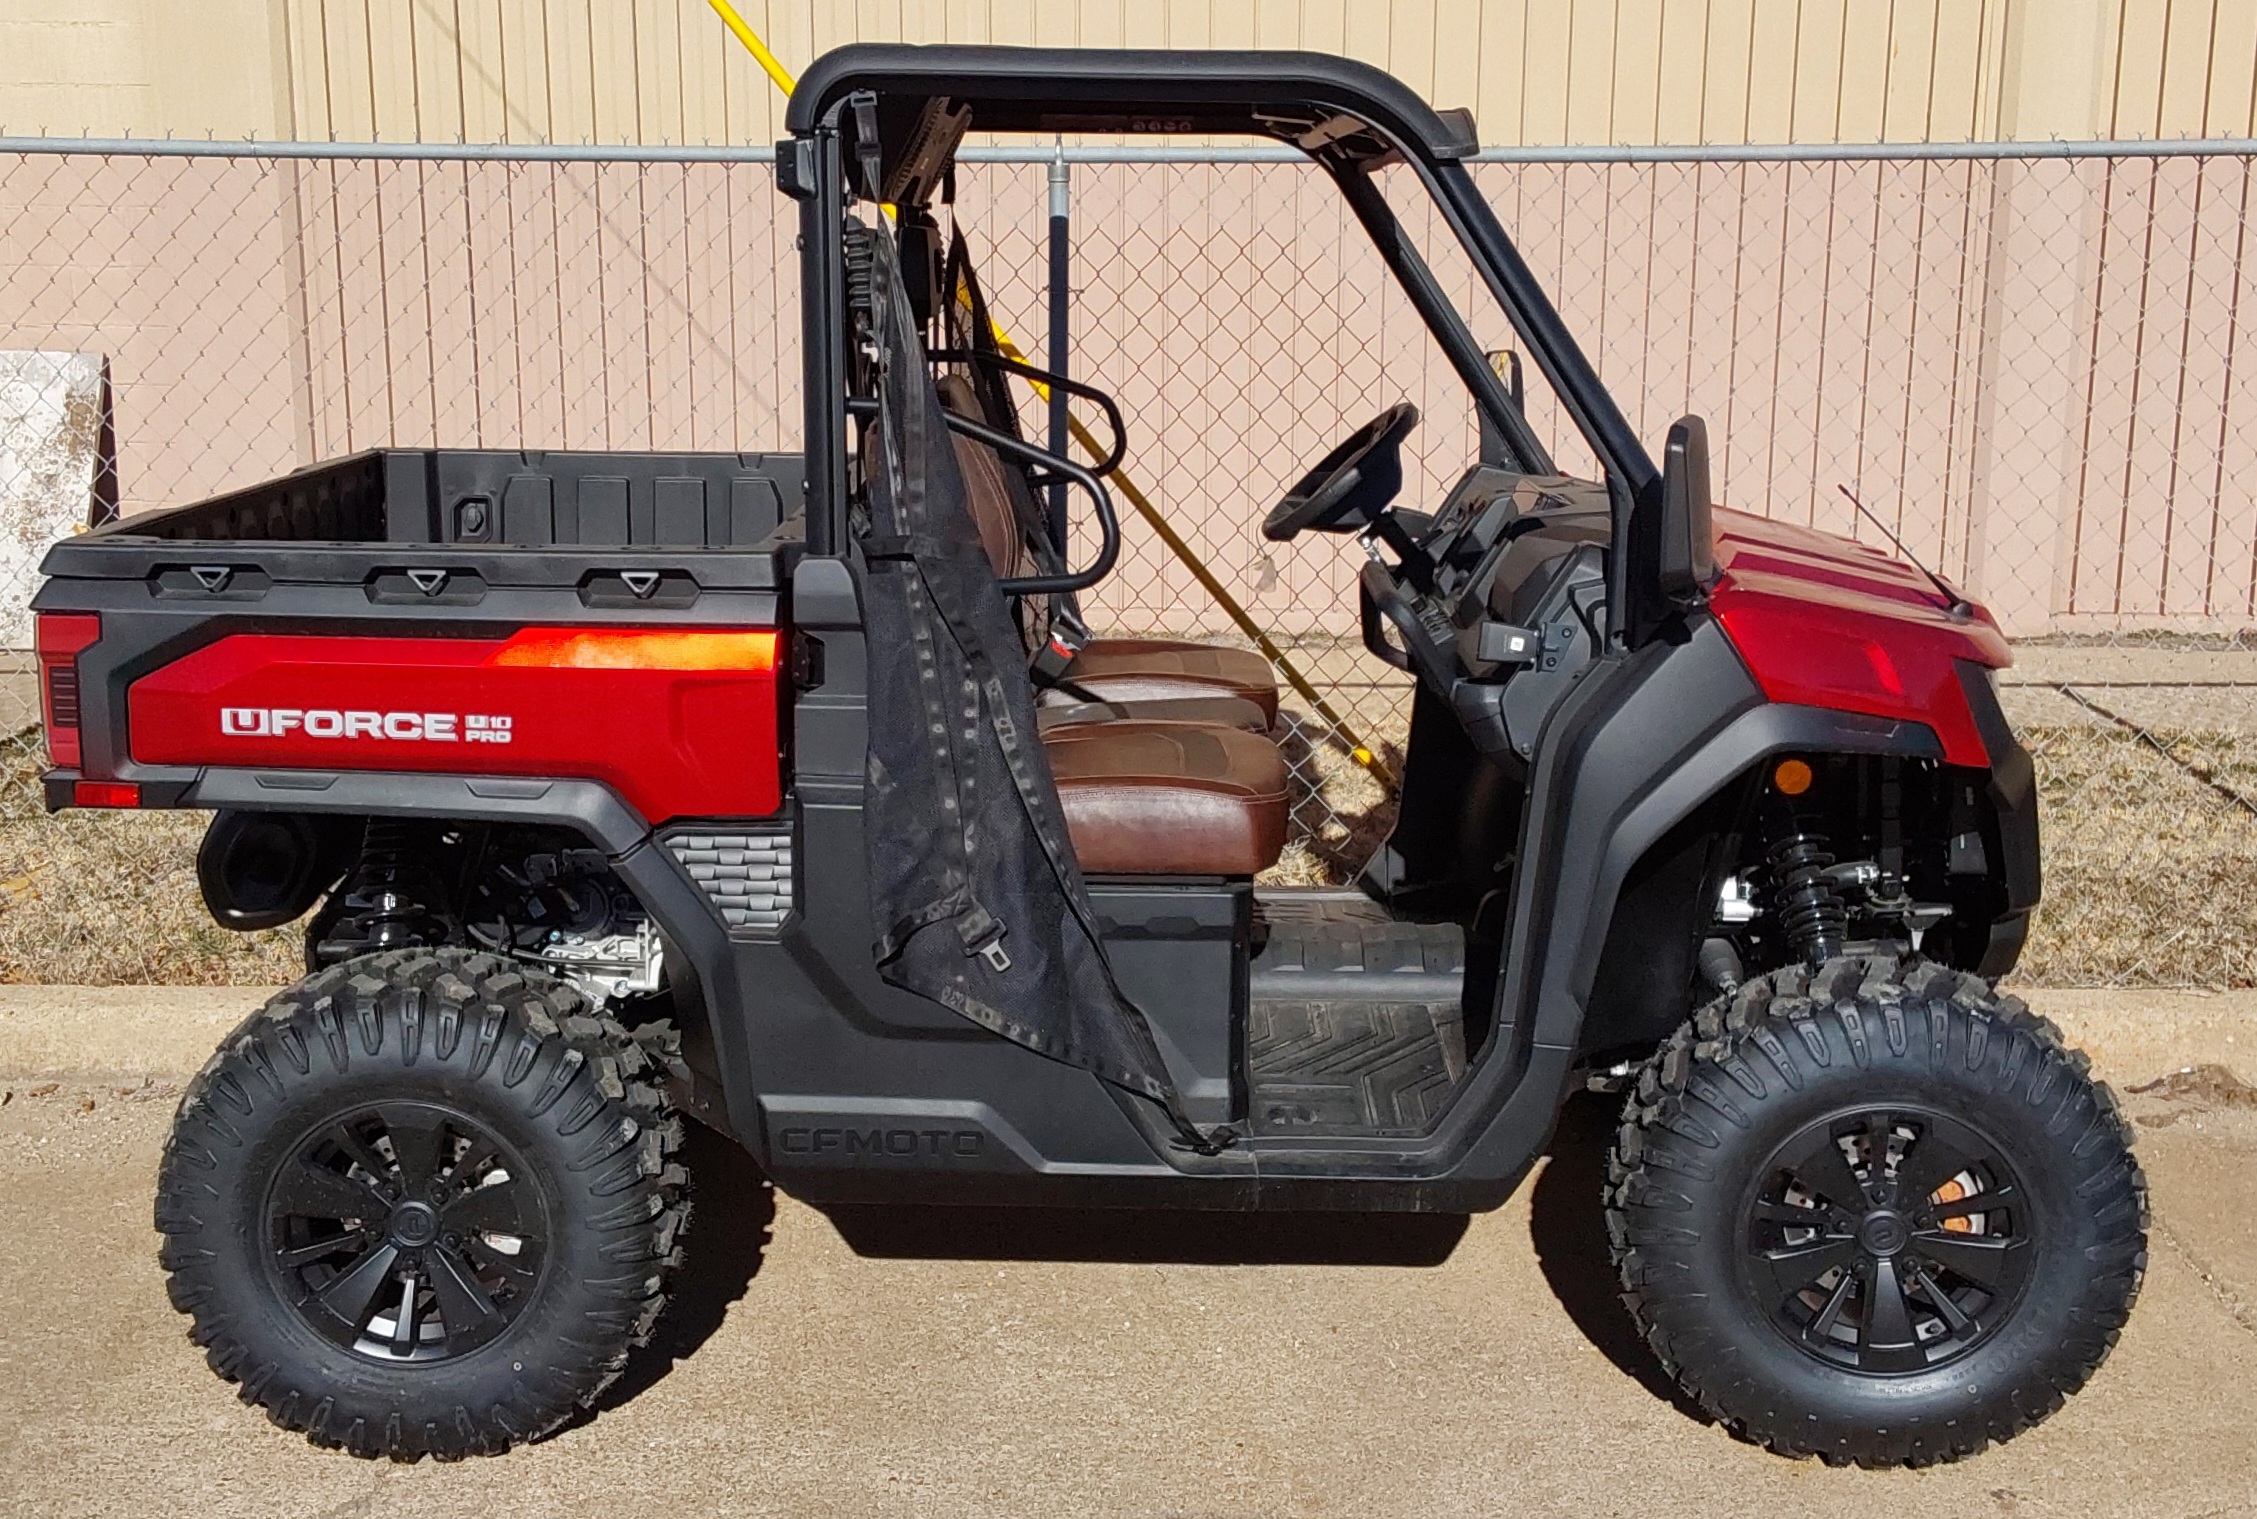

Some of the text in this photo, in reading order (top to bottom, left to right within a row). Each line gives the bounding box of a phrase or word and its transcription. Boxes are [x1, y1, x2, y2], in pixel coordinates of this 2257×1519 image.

[221, 708, 458, 741] UFORCE
[465, 715, 511, 729] U10
[465, 730, 511, 743] PRO
[780, 1128, 984, 1157] CFMOTO
